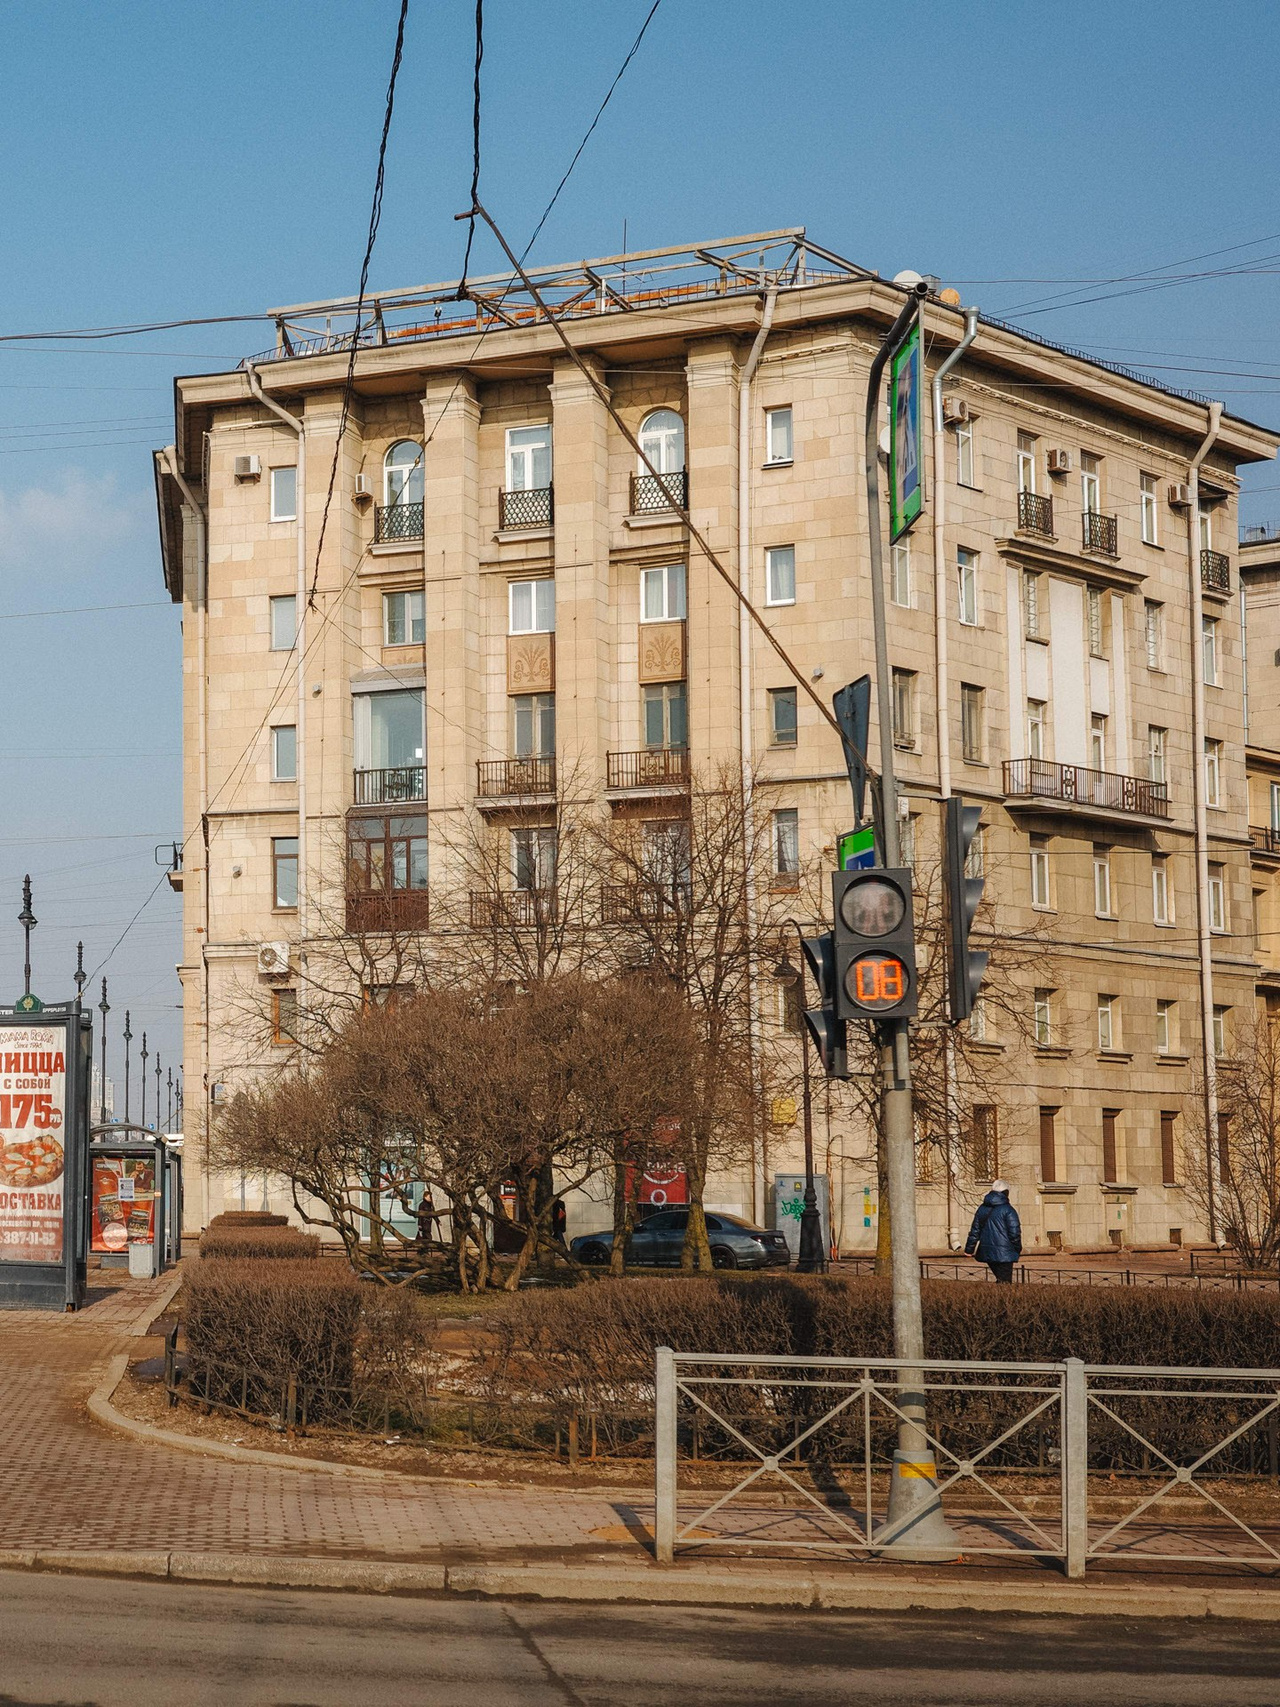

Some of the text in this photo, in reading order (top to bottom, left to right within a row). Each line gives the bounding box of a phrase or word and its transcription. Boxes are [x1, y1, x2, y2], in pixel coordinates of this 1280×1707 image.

[856, 960, 903, 1001] 08
[0, 1031, 29, 1044] MAMA
[15, 1076, 51, 1089] СОБОЙ
[0, 1094, 53, 1130] 175
